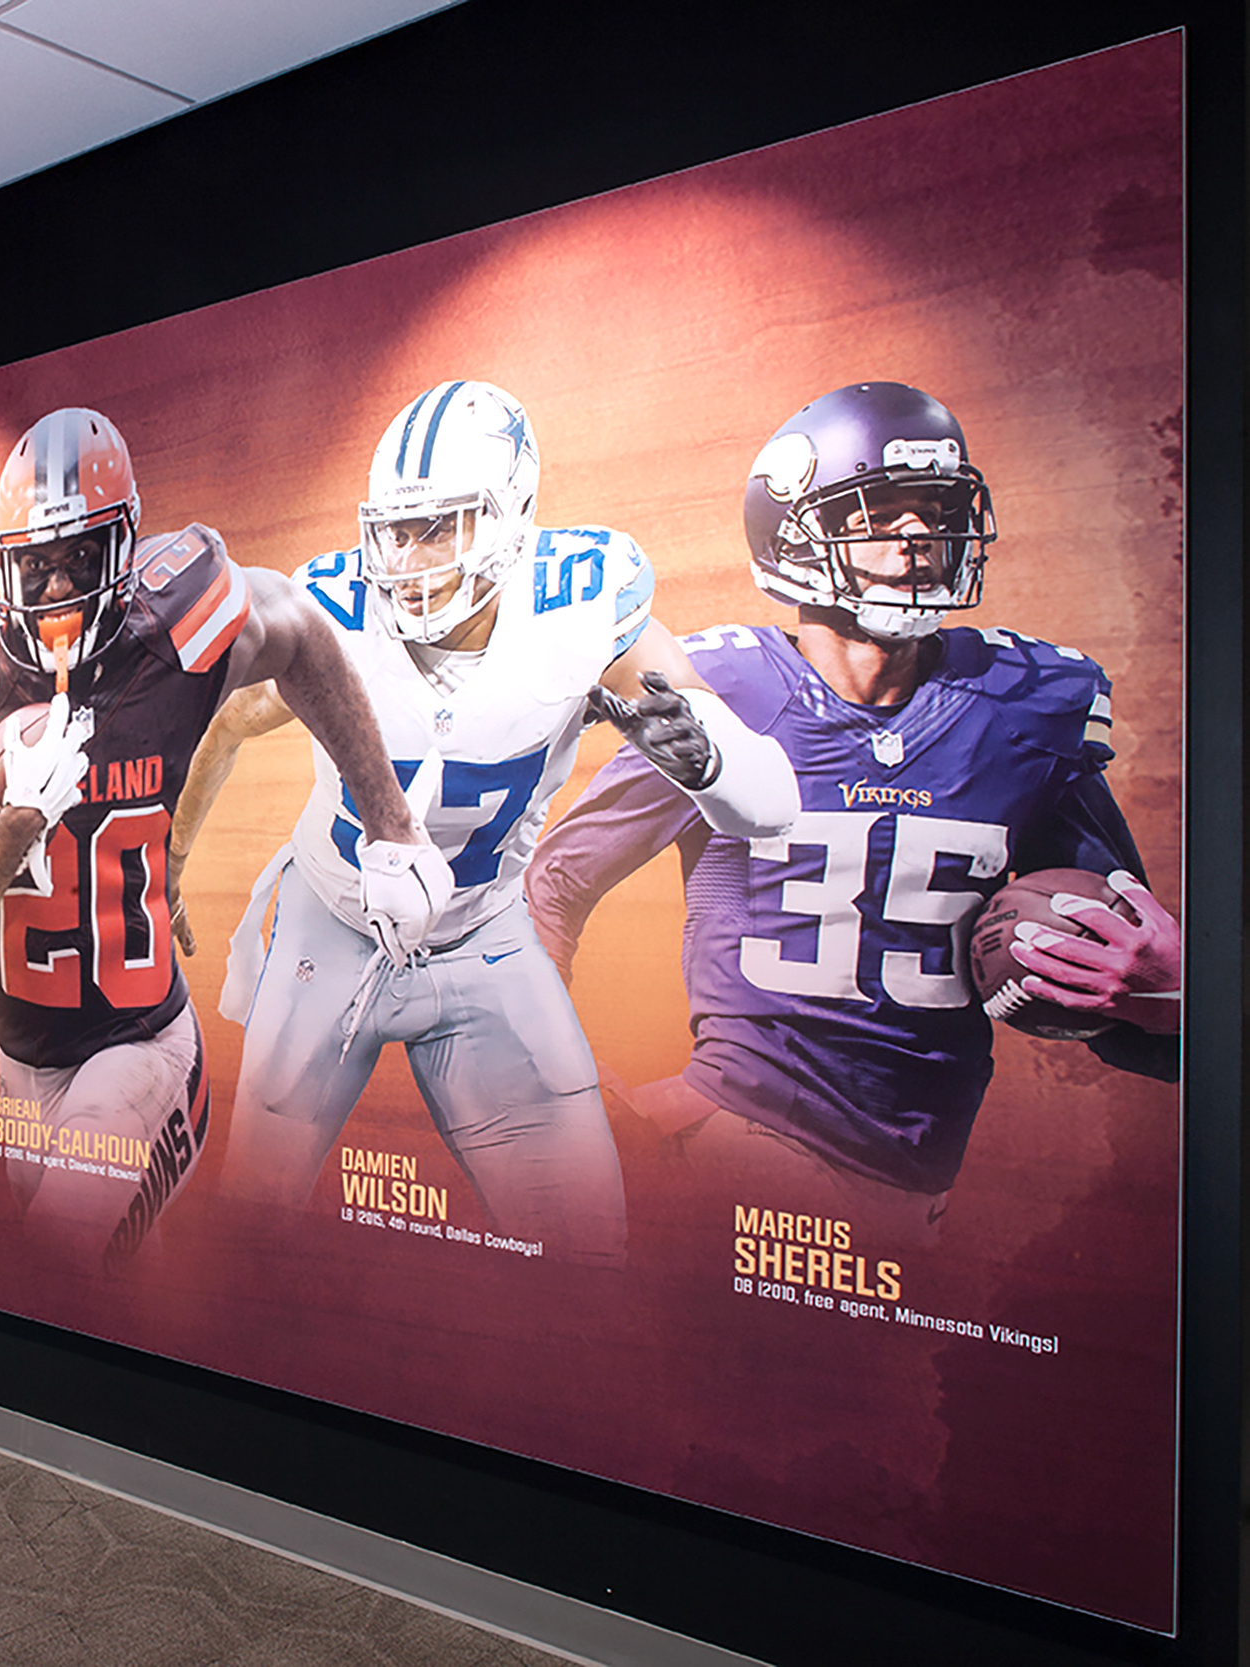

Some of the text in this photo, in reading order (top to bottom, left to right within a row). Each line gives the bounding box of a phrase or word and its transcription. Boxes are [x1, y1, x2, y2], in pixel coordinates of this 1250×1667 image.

[0, 805, 172, 1009] 20
[739, 810, 1010, 1009] 35
[341, 1147, 417, 1182] DAMIEN
[341, 1172, 448, 1221] WILSON
[340, 1206, 354, 1222] LB
[388, 1215, 407, 1232] 4th
[445, 1224, 482, 1246] Dallas
[734, 1204, 852, 1250] MARCUS
[734, 1236, 902, 1302] SHERELS
[733, 1276, 753, 1294] DB
[803, 1289, 835, 1310] free
[894, 1306, 985, 1339] Minnesota
